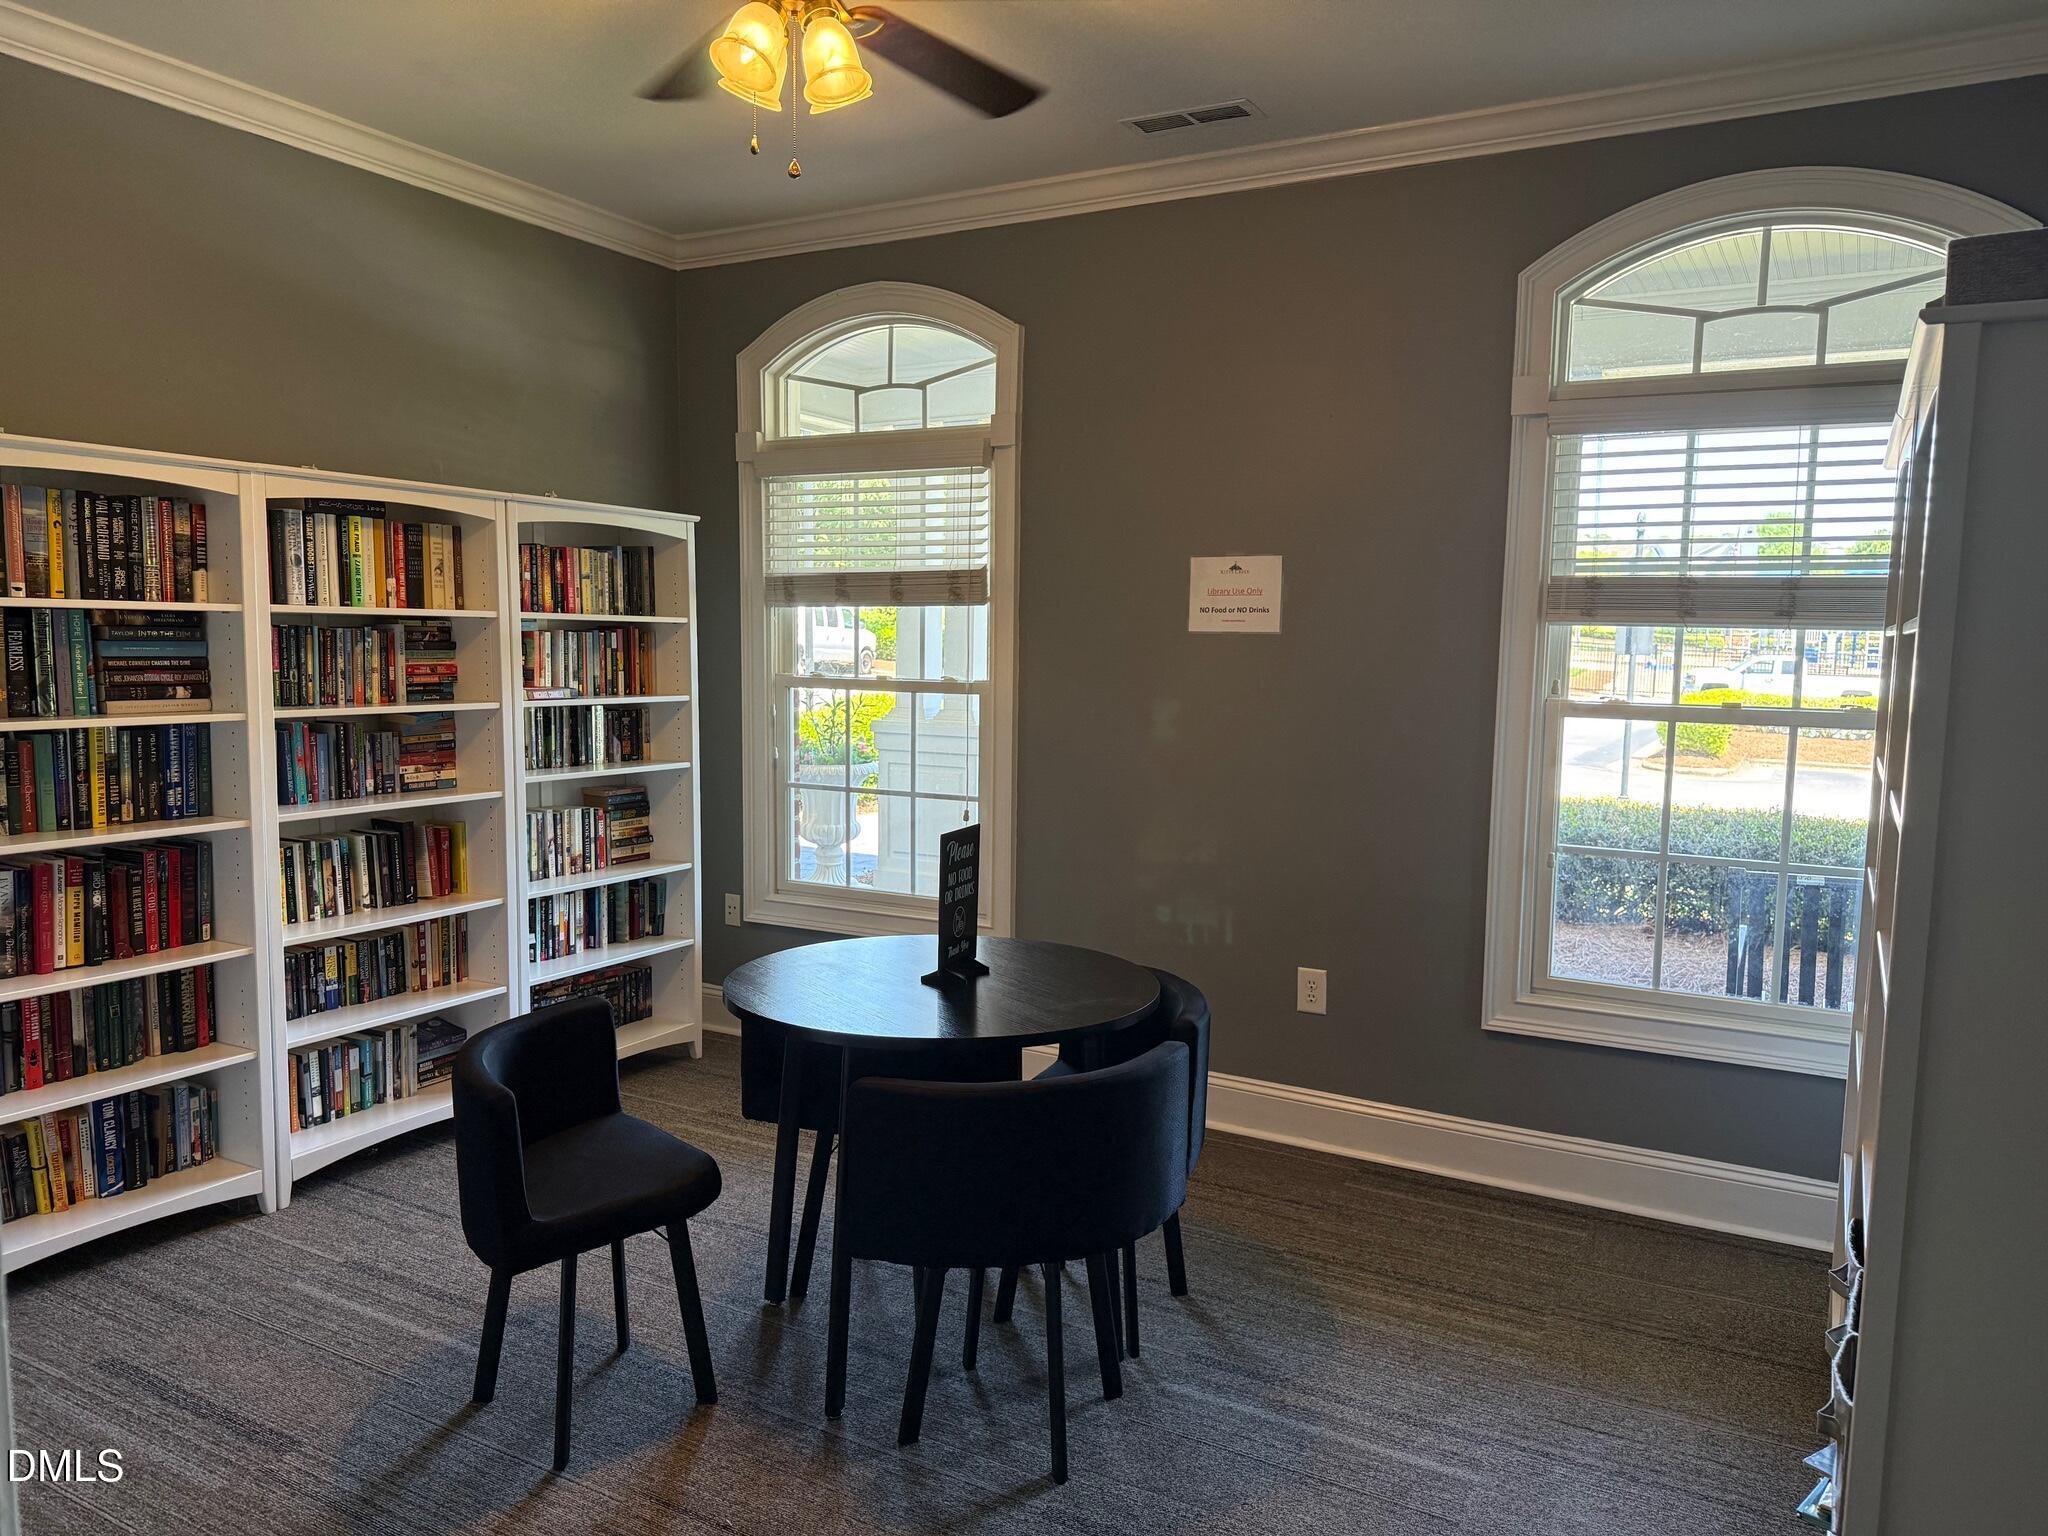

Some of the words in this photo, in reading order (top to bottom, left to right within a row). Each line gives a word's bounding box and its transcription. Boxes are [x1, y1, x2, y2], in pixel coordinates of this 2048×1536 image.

[95, 499, 109, 515] VAL
[130, 498, 138, 524] VINCE
[96, 516, 110, 560] McDERMID
[131, 525, 139, 551] FLYNN
[305, 516, 314, 539] STUART
[306, 541, 314, 564] WOODS
[1207, 587, 1230, 596] Library
[1246, 587, 1263, 596] Only
[73, 615, 81, 637] HOPE
[8, 630, 24, 672] FEARLESS
[76, 672, 84, 695] Ridker
[169, 728, 181, 749] CLIVE
[23, 769, 32, 785] John
[170, 749, 181, 783] CUSSLER
[24, 785, 32, 813] Cheever
[946, 840, 975, 866] Please
[92, 871, 101, 889] BIRD
[146, 853, 155, 884] SECRETS
[947, 872, 957, 887] NO
[958, 867, 973, 883] FOOD
[73, 890, 81, 910] Terry
[92, 889, 101, 908] BOX
[147, 892, 156, 914] CODE
[944, 890, 953, 905] OR
[954, 881, 975, 902] DRINKS
[73, 912, 81, 944] McMillan
[102, 1100, 114, 1119] TOM
[103, 1120, 117, 1150] CLANCY
[11, 1146, 23, 1176] BROWN
